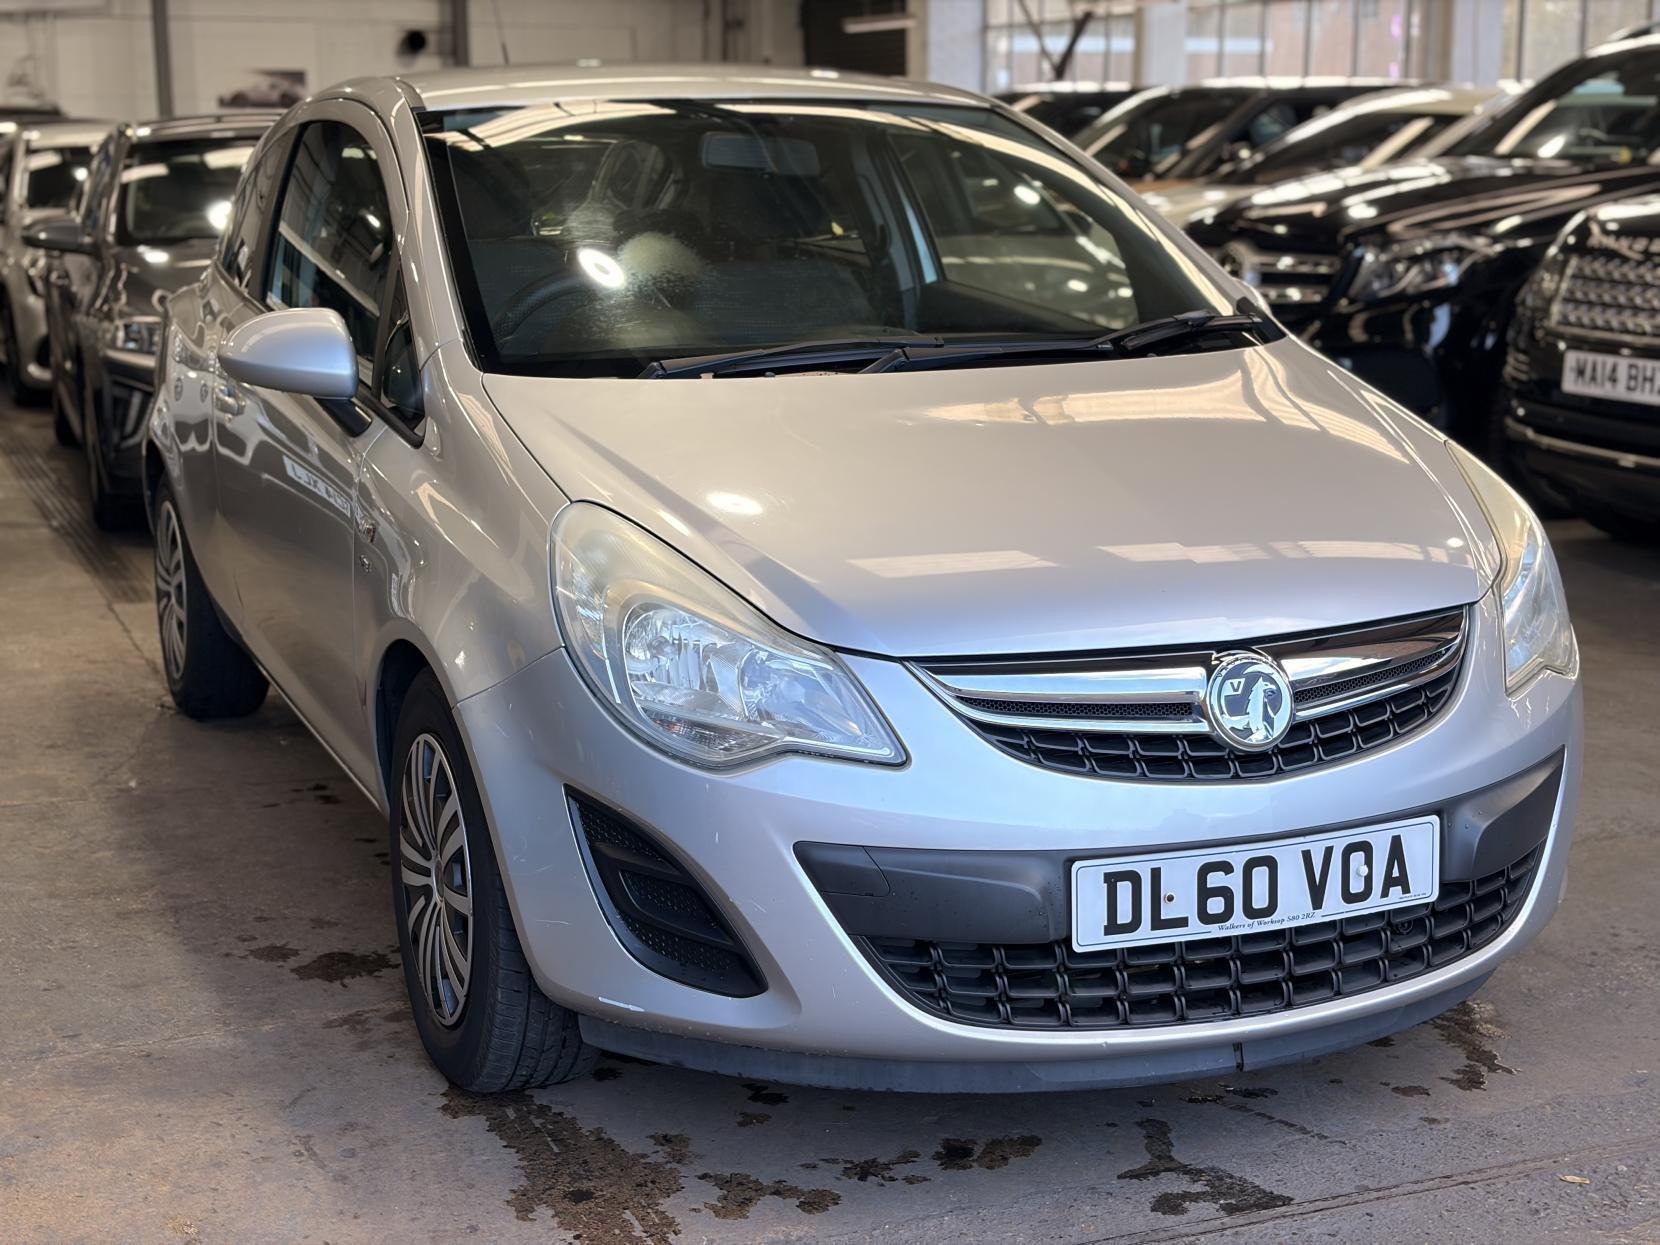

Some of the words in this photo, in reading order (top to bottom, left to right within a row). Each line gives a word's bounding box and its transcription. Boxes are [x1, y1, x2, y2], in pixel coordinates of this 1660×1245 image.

[1103, 855, 1279, 936] DL60
[1301, 834, 1412, 911] VOA
[1217, 923, 1246, 931] Walkers
[1247, 921, 1255, 929] of
[1257, 918, 1285, 926] Worksop
[1287, 914, 1300, 922] S80
